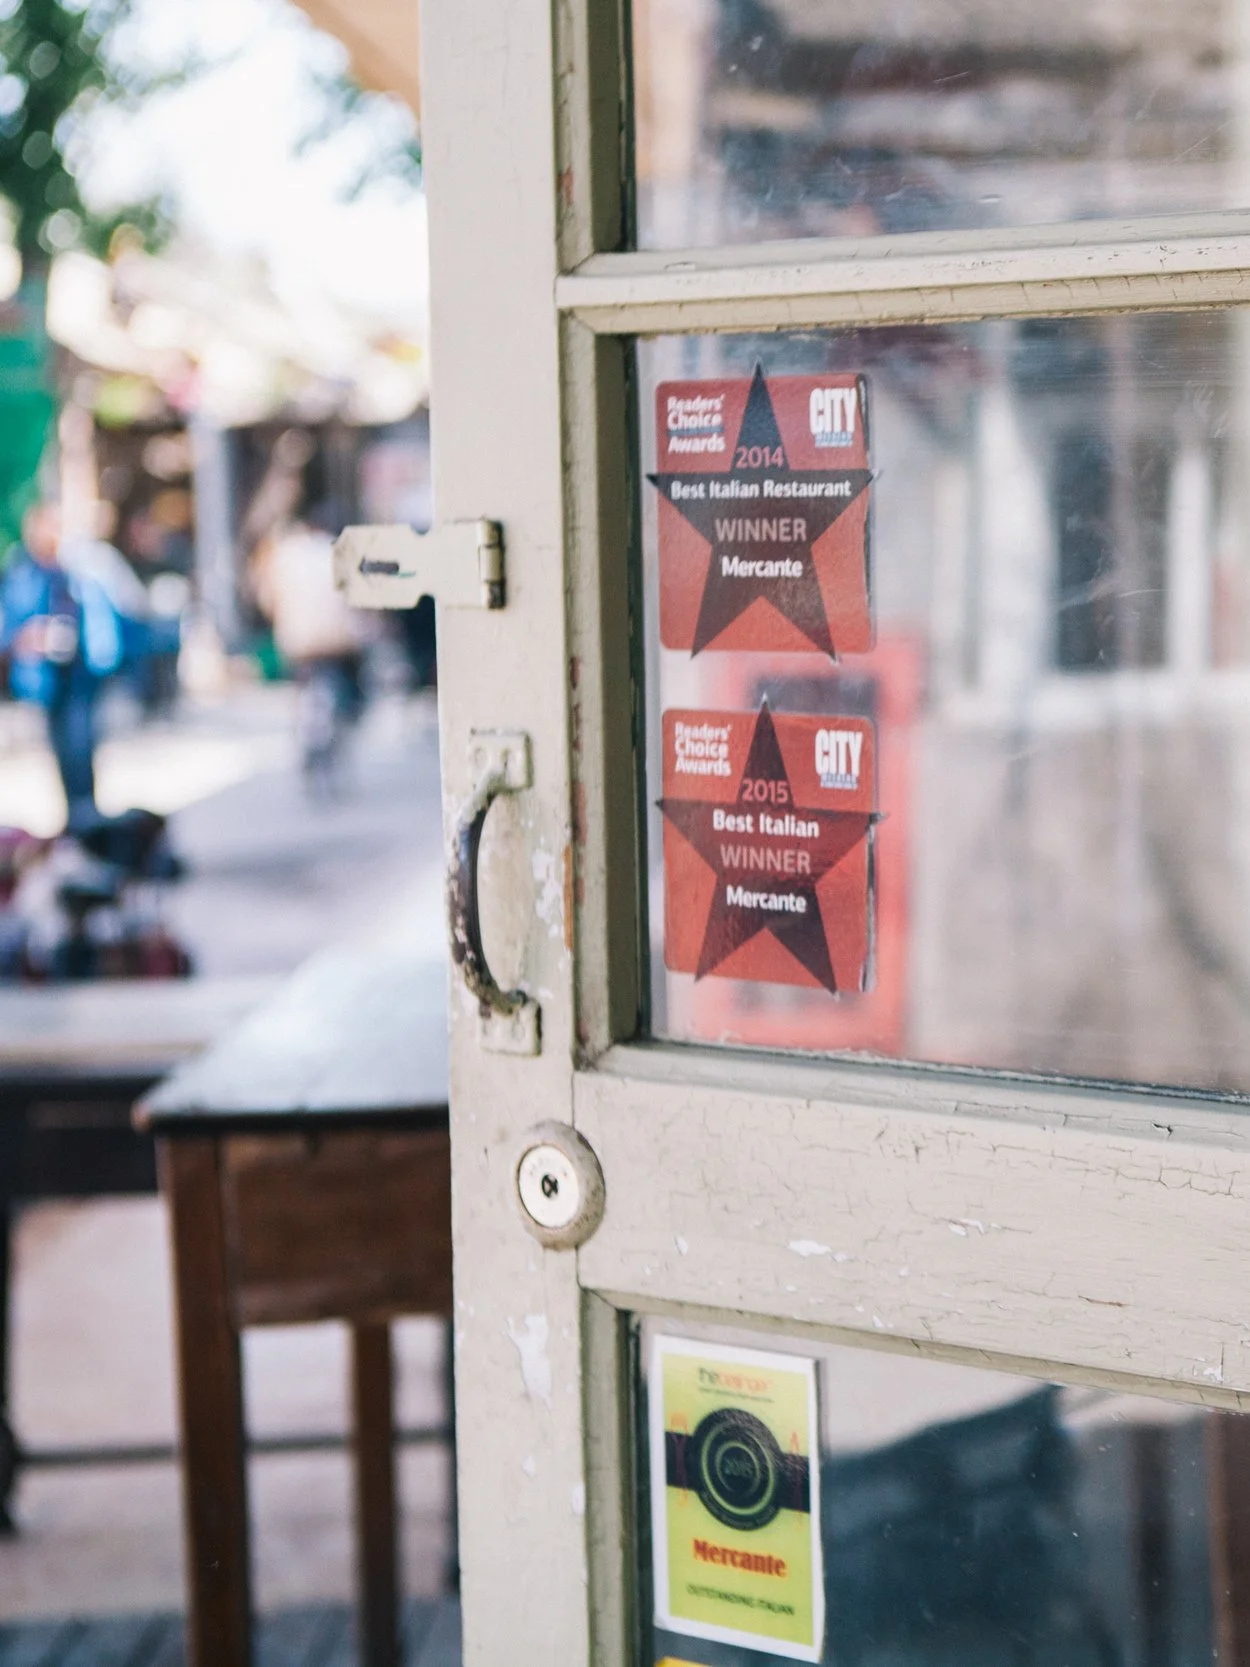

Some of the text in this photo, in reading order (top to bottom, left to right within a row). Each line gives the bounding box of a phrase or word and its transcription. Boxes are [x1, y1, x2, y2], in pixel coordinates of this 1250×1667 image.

[668, 411, 722, 429] Choice
[810, 387, 857, 435] CITY
[668, 433, 726, 454] Awards
[736, 446, 784, 468] 2014
[671, 480, 851, 499] Best Italian Restaurant
[715, 518, 807, 542] WINNER
[722, 556, 803, 577] Mercante
[675, 739, 728, 757] Choice
[815, 729, 863, 776] CITY
[675, 757, 731, 777] Awards
[742, 779, 788, 803] 2015
[713, 809, 819, 838] Best Italian
[720, 844, 811, 874] WINNER
[727, 885, 806, 913] Mercante
[693, 1538, 786, 1577] Mercante
